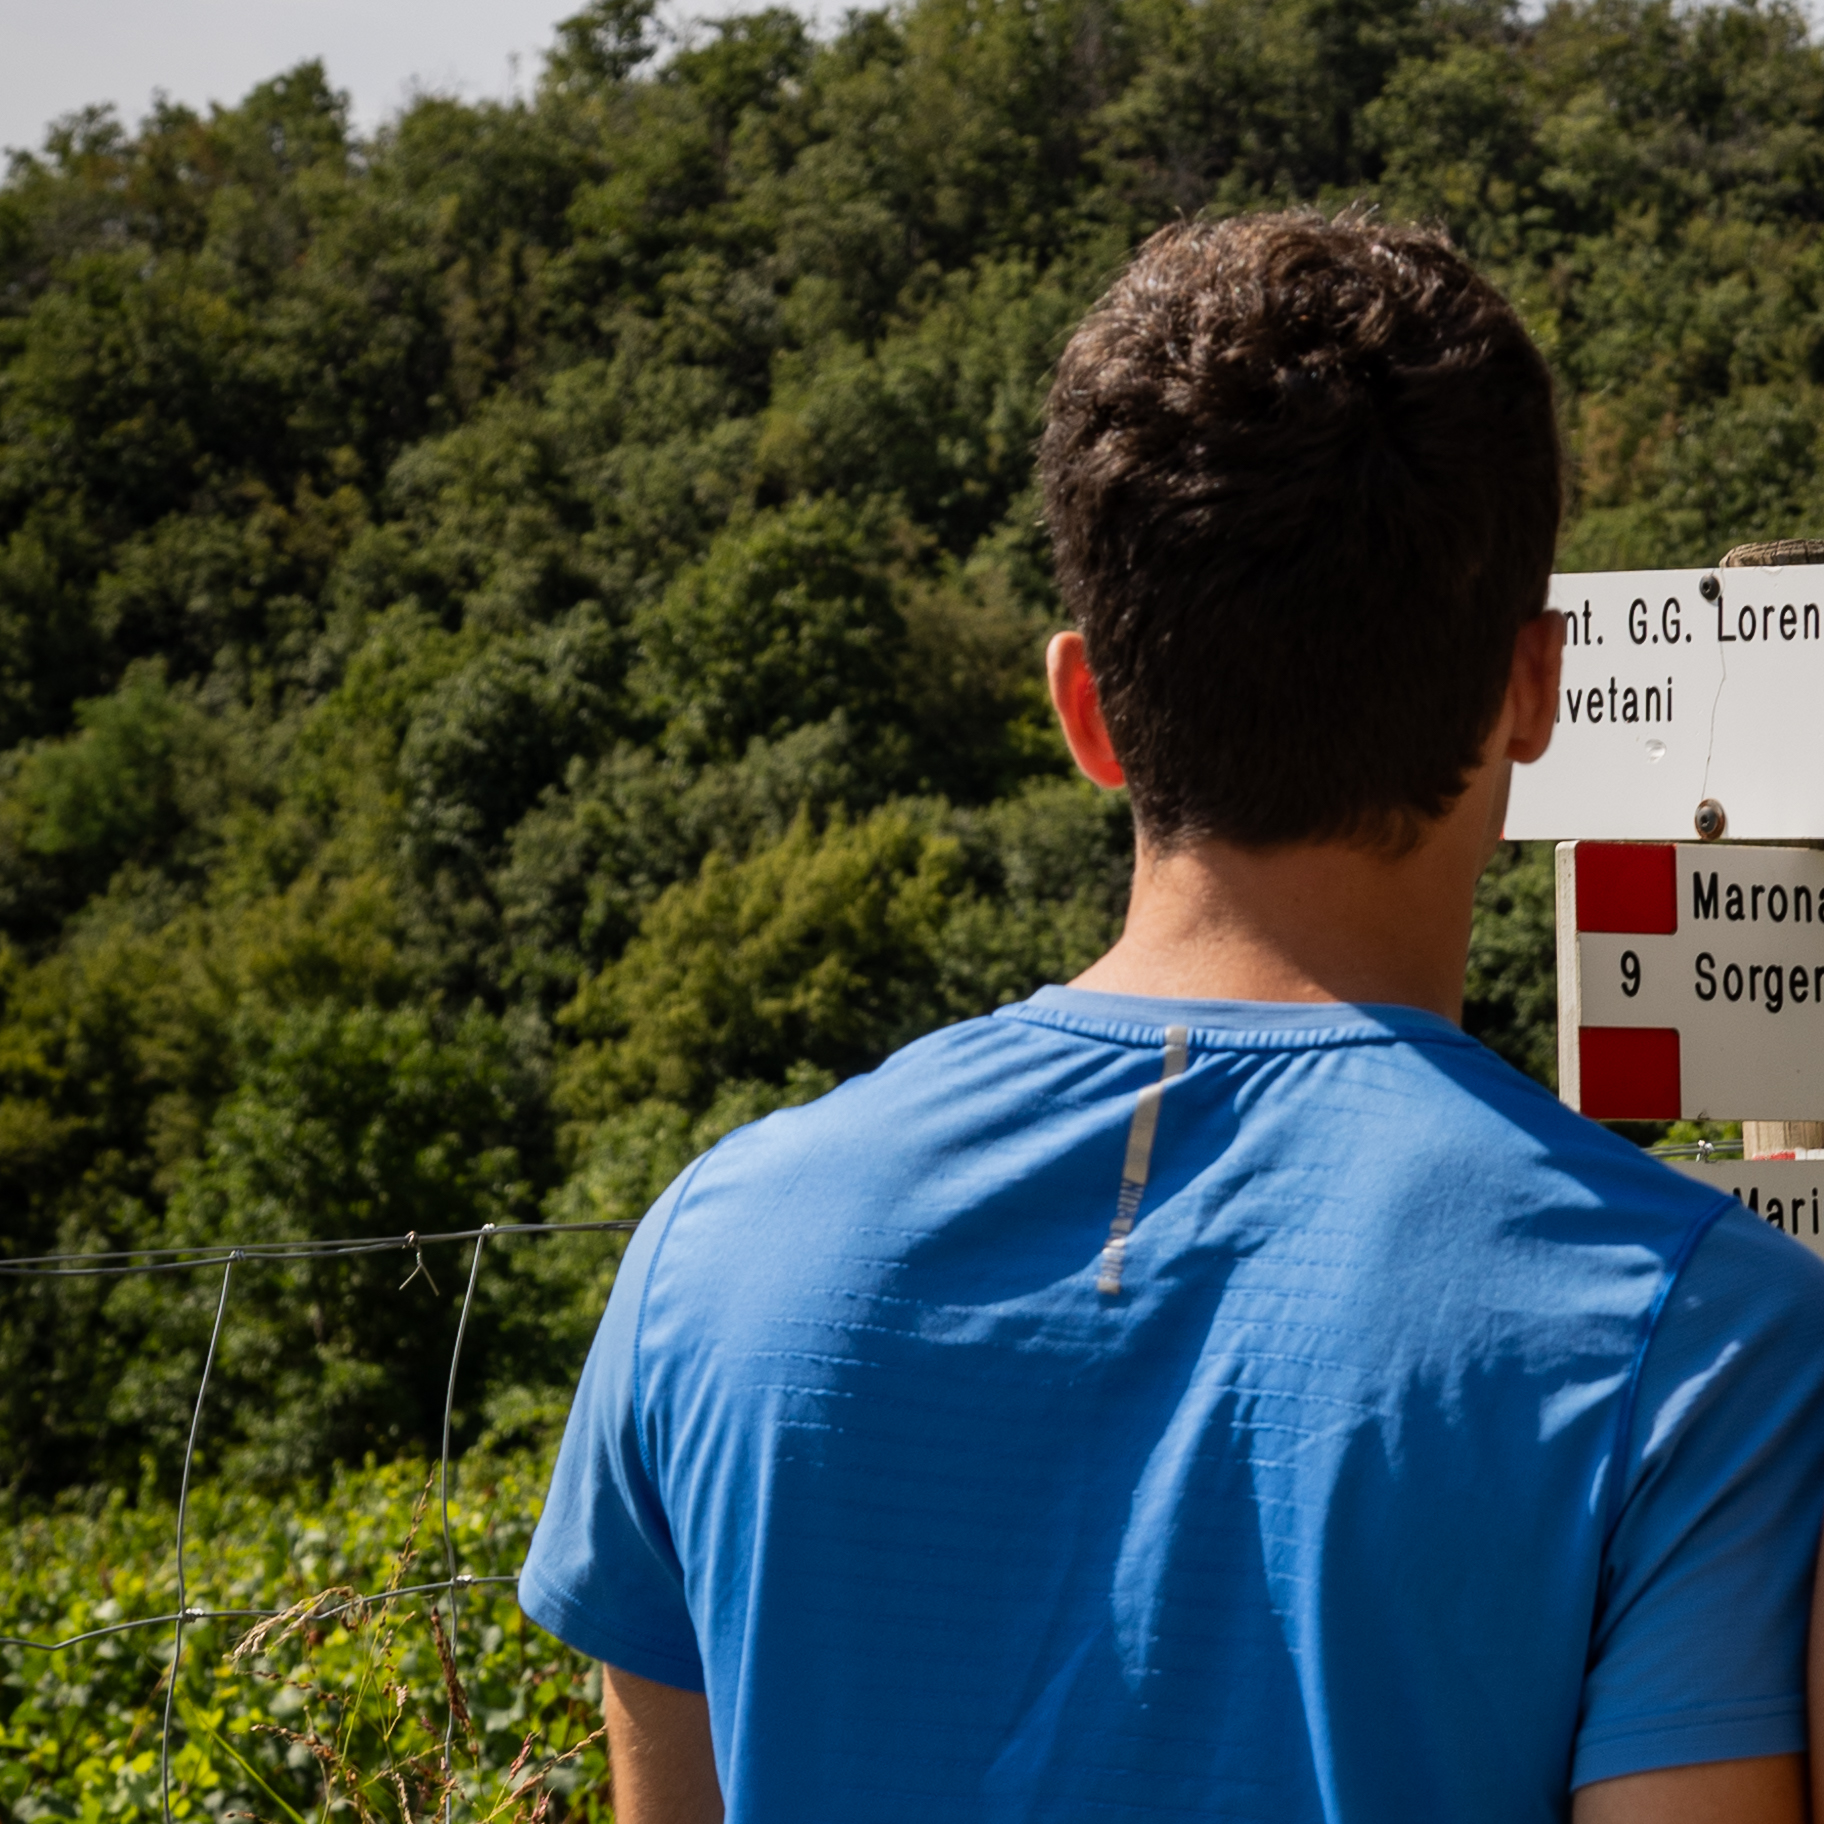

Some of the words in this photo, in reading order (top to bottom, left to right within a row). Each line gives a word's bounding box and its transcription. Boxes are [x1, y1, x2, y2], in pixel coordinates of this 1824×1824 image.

[1628, 597, 1692, 645] G.G.
[1556, 676, 1673, 724] vetani
[1619, 949, 1642, 998] 9
